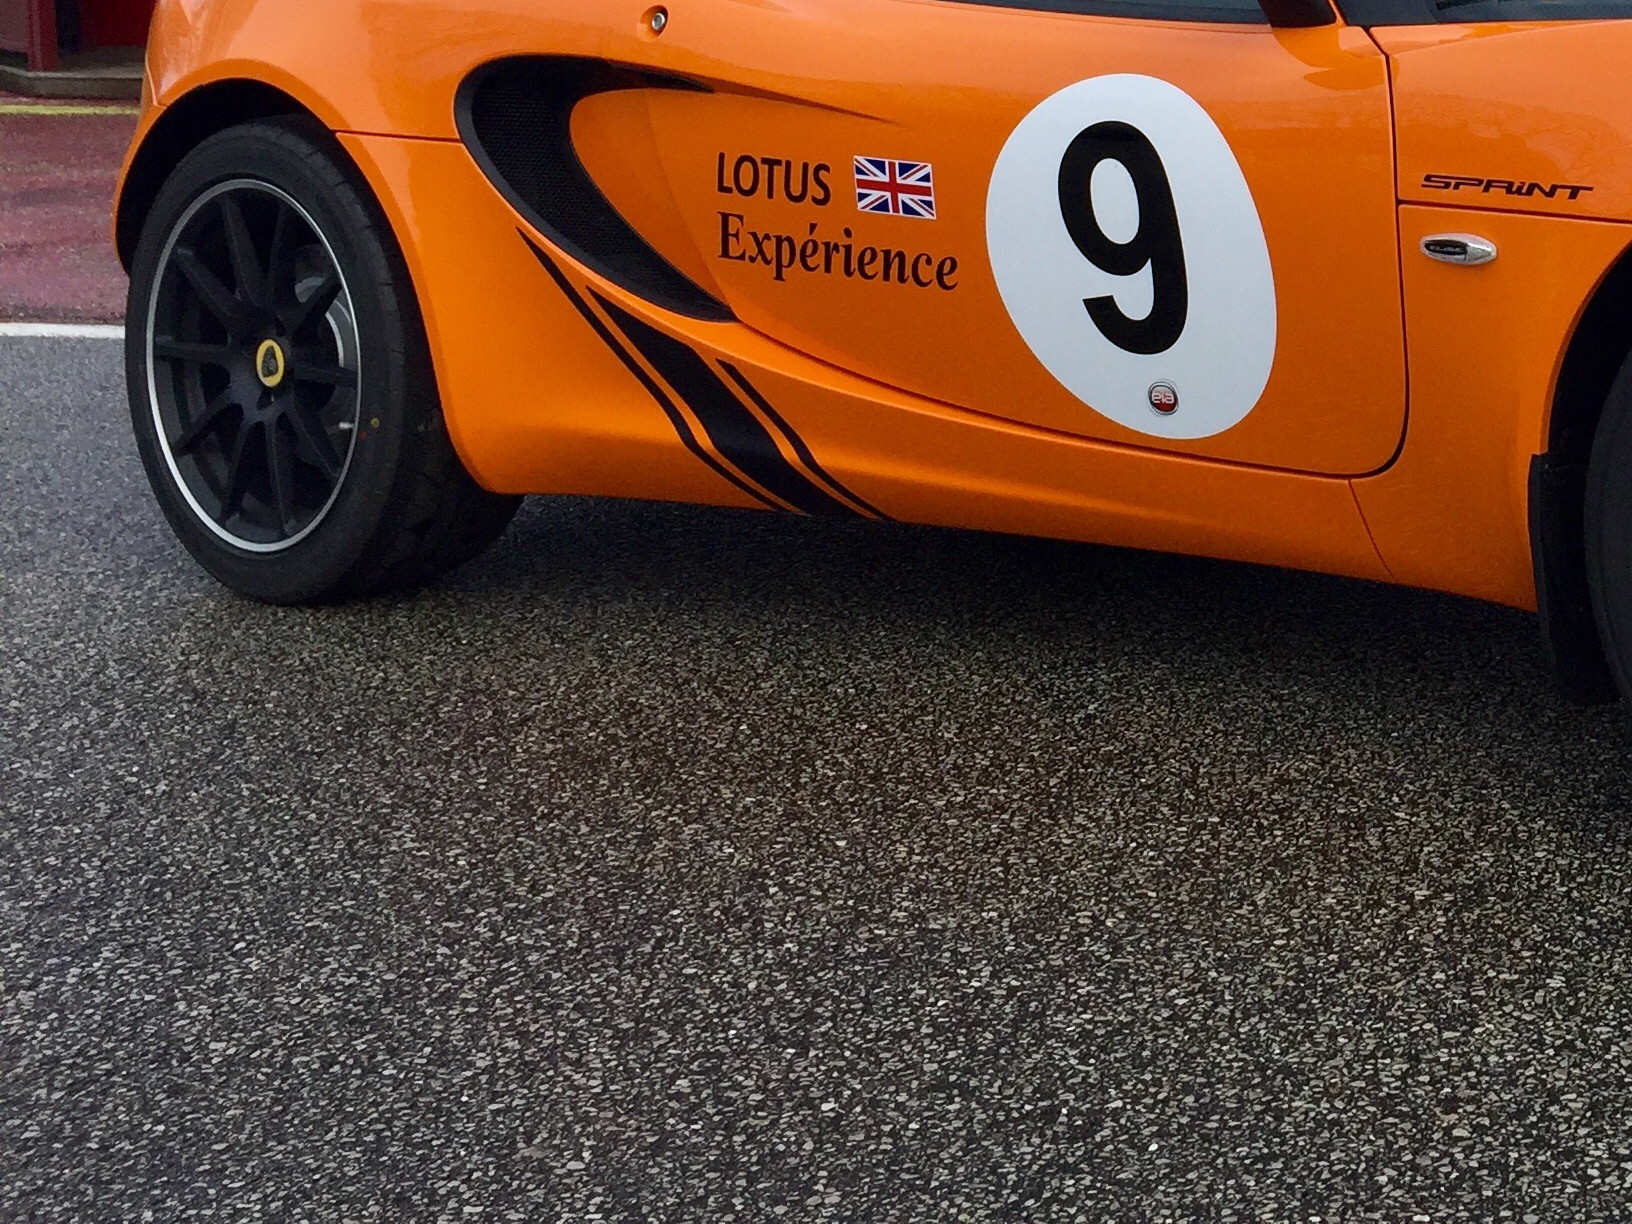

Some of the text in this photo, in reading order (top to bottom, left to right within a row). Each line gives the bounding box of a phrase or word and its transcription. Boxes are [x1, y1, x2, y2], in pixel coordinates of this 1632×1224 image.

[717, 152, 831, 207] LOTUS
[717, 211, 959, 291] Expérience
[1058, 120, 1188, 355] 9
